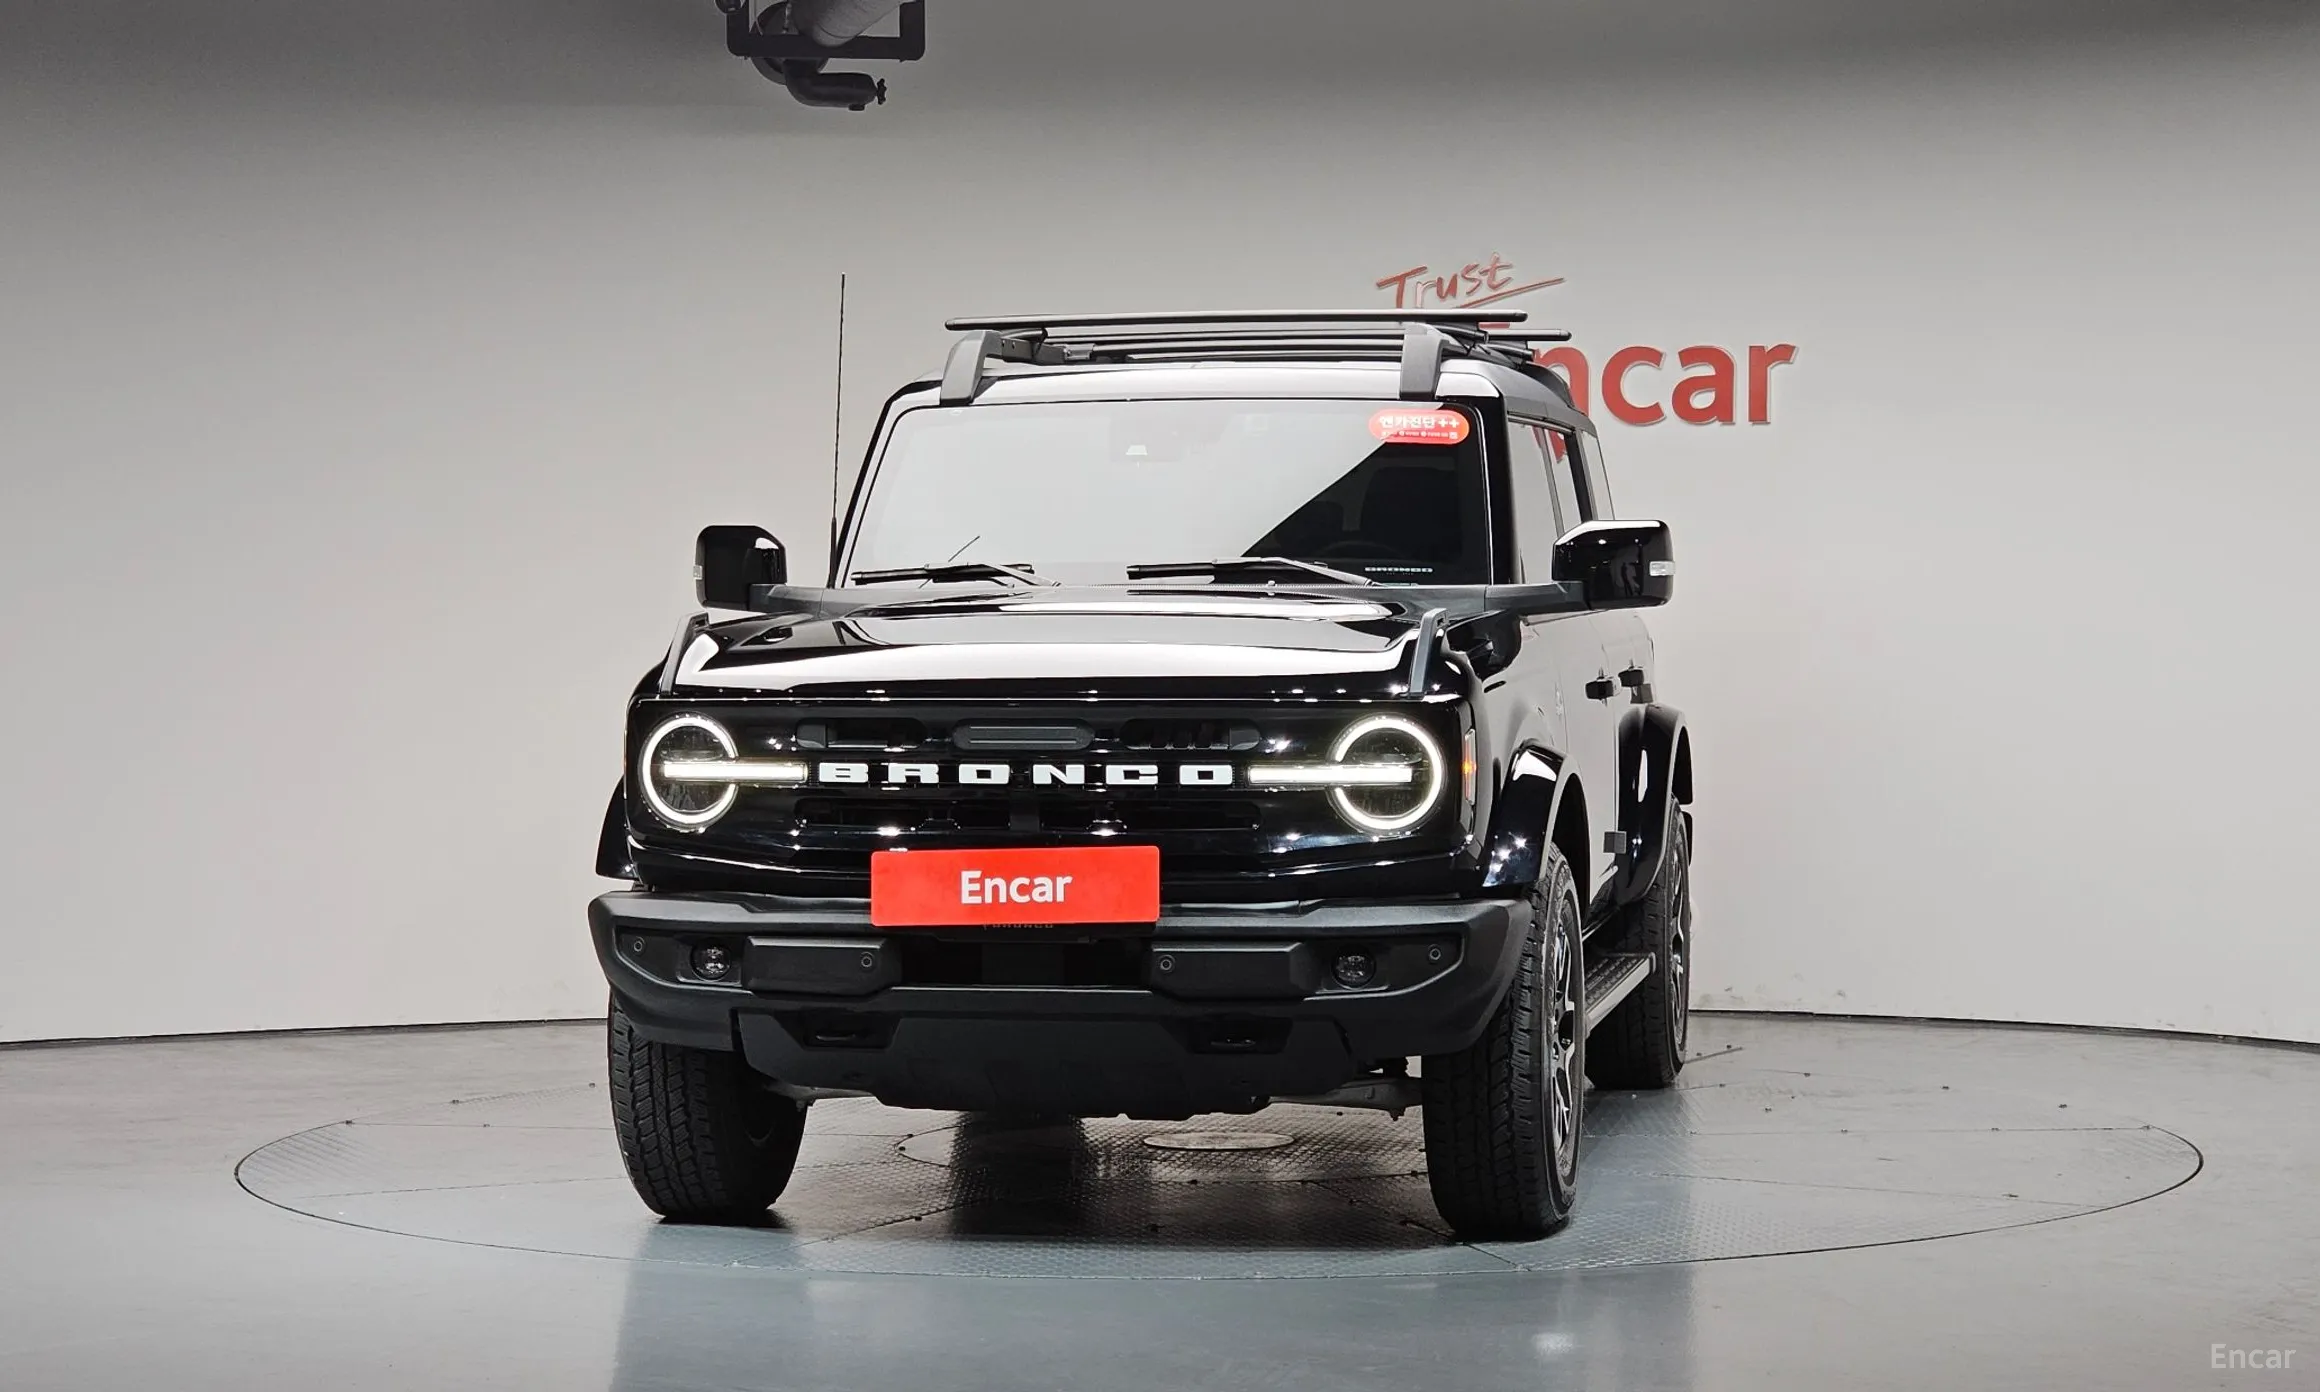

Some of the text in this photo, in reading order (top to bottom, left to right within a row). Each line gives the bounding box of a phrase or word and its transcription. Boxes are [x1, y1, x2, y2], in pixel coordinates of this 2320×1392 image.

[1376, 252, 1514, 309] Trust
[1478, 322, 1798, 426] ncar
[818, 762, 1233, 785] BRONCO
[960, 869, 1073, 905] Encar
